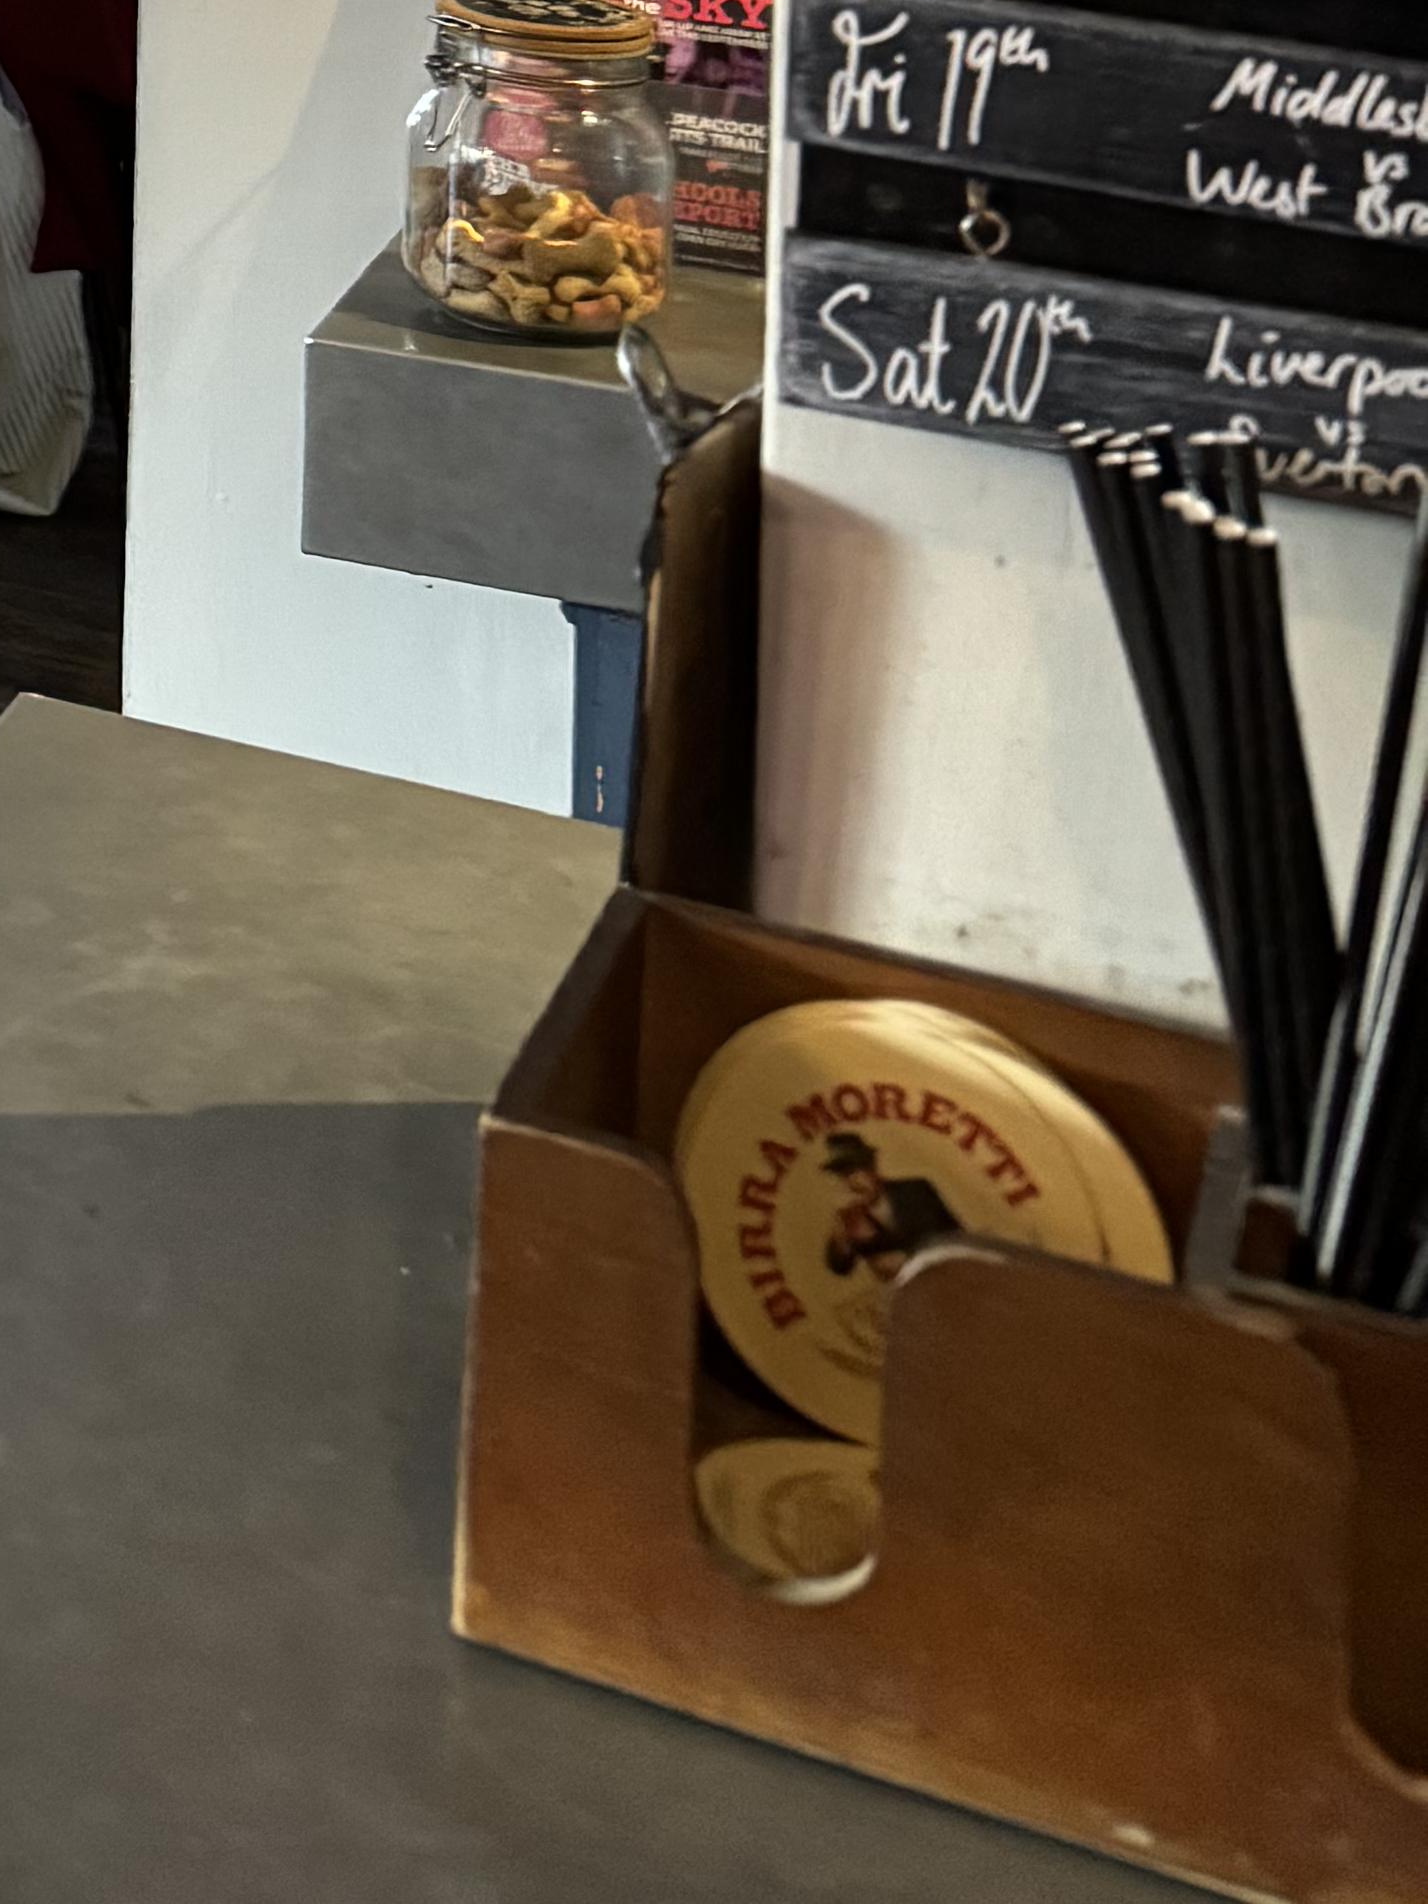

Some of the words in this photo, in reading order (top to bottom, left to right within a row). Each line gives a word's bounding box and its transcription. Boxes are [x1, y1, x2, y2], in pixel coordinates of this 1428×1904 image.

[825, 9, 911, 138] Fri
[937, 26, 1049, 150] 19th
[1186, 148, 1330, 221] West
[1363, 148, 1410, 185] vs
[818, 284, 956, 416] Sat
[1227, 412, 1428, 497] verton
[738, 1138, 809, 1331] BIRRA
[785, 1081, 1042, 1208] MORETTI
